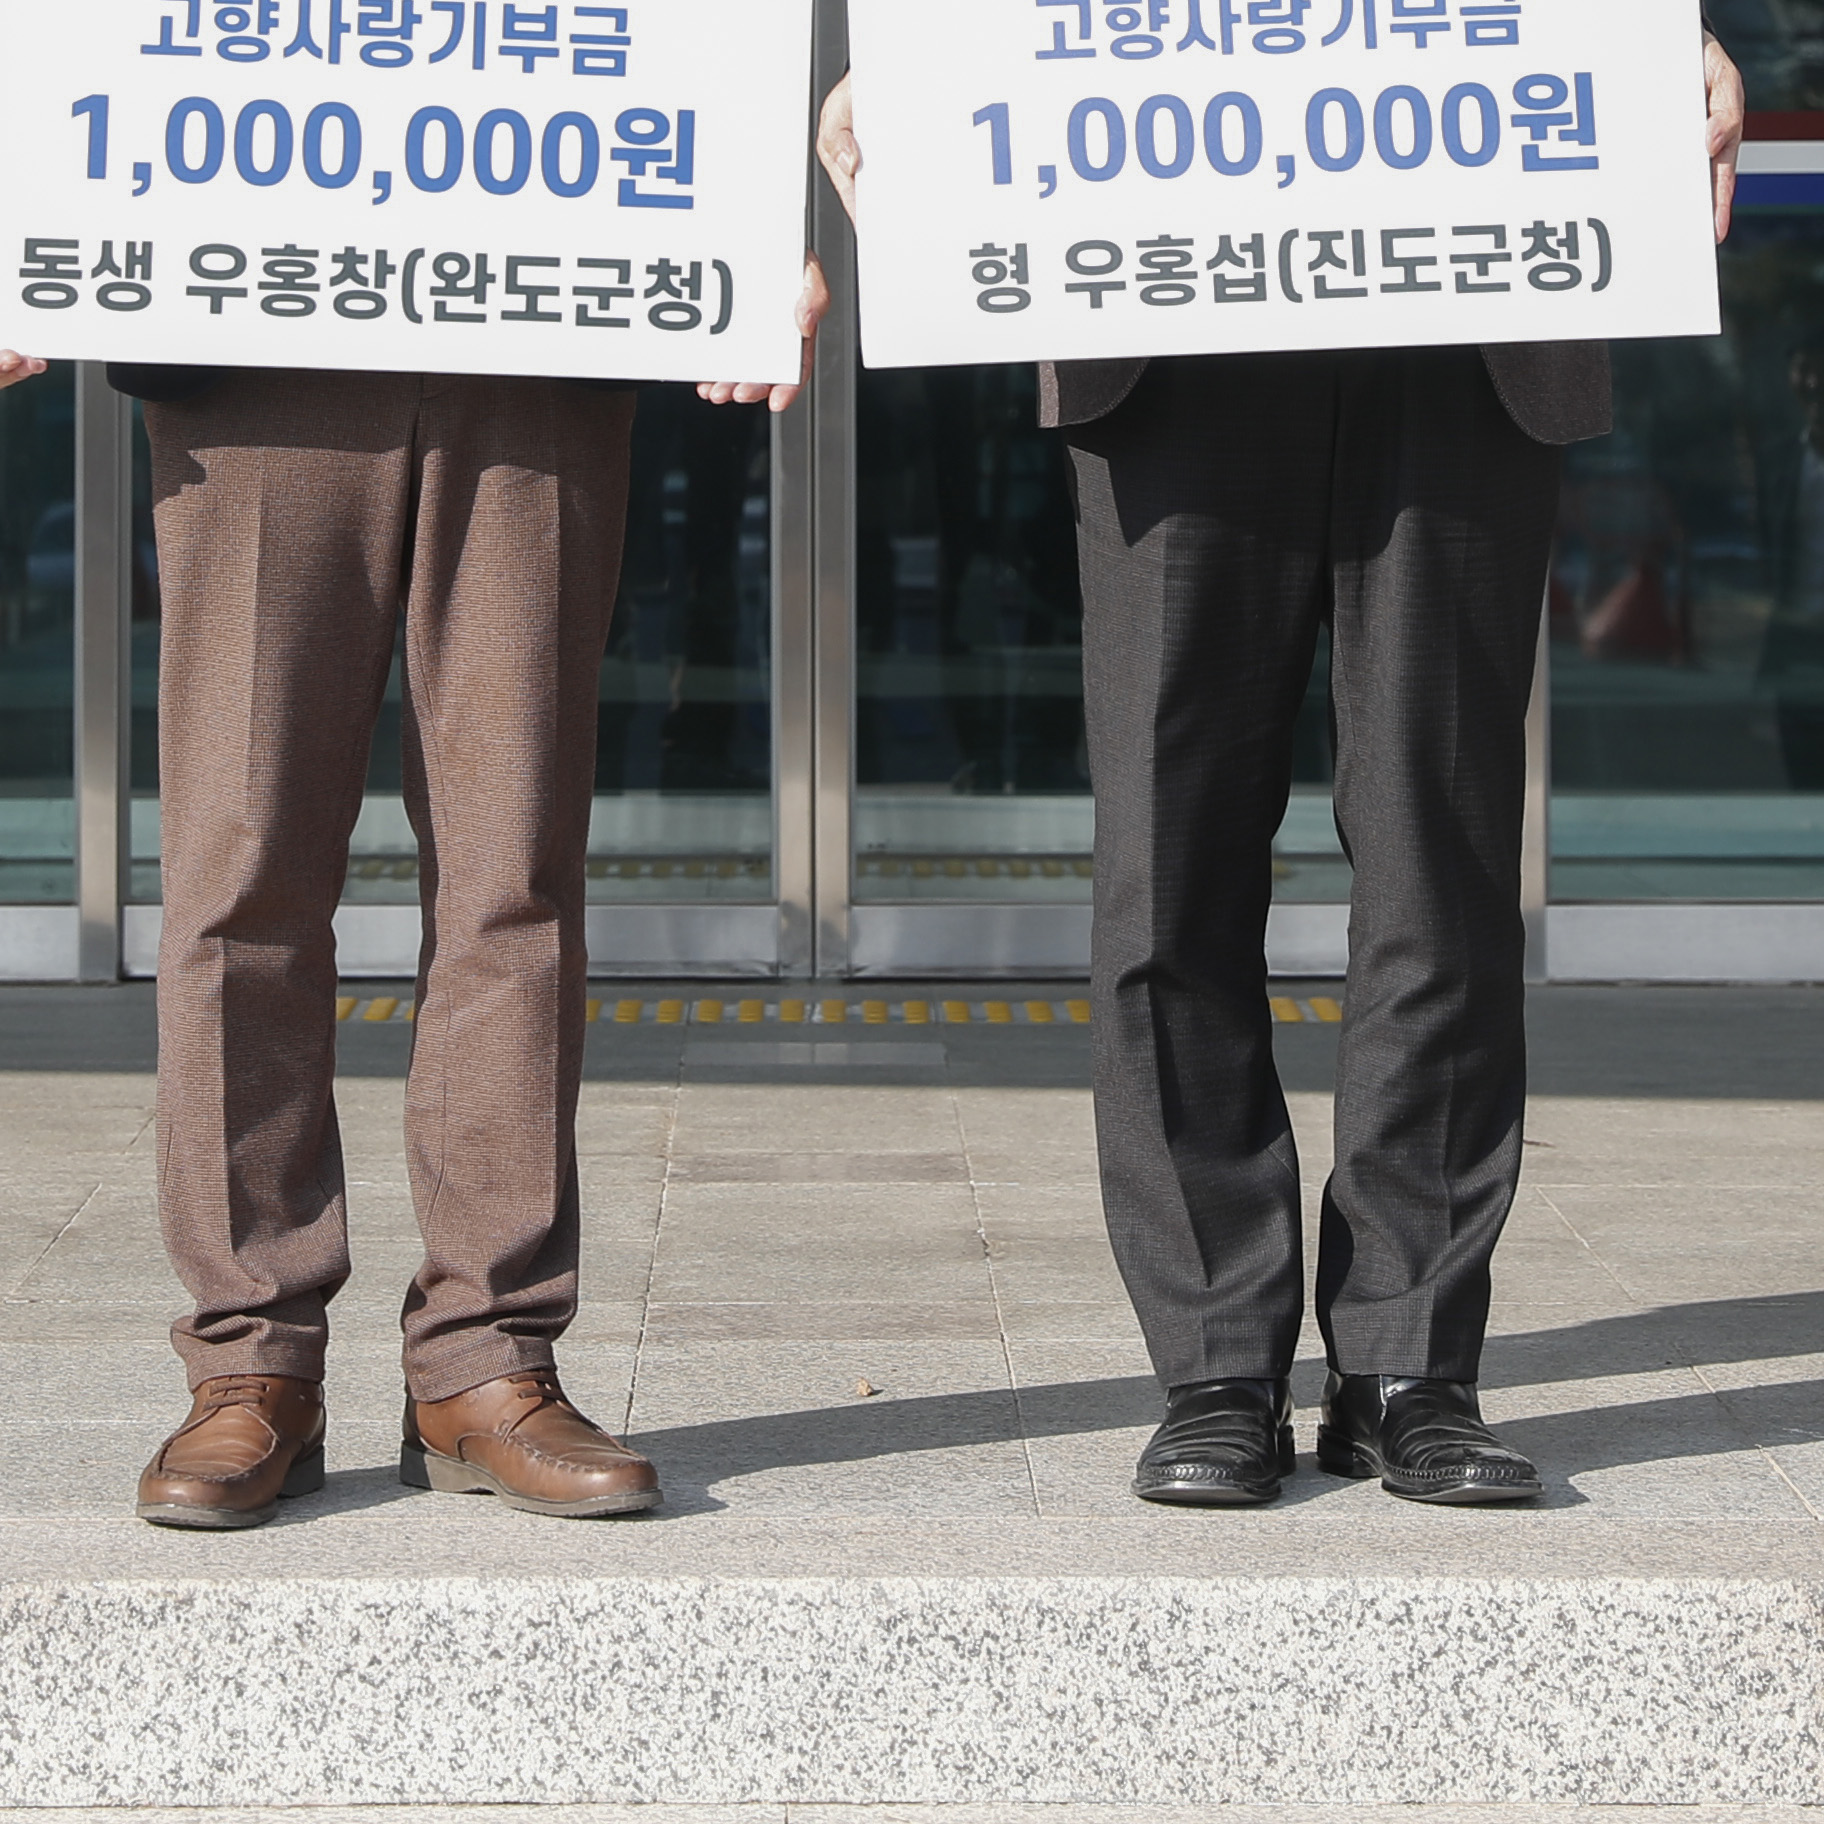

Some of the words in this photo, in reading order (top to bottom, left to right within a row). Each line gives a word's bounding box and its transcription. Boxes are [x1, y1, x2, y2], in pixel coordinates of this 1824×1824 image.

[71, 93, 696, 210] 1,000,000원
[972, 71, 1600, 199] 1,000,000원
[18, 237, 154, 312] 동생
[185, 243, 734, 336] 우홍창(완도군청)
[968, 242, 1032, 313] 형
[1064, 217, 1613, 310] 우홍섭(진도군청)
